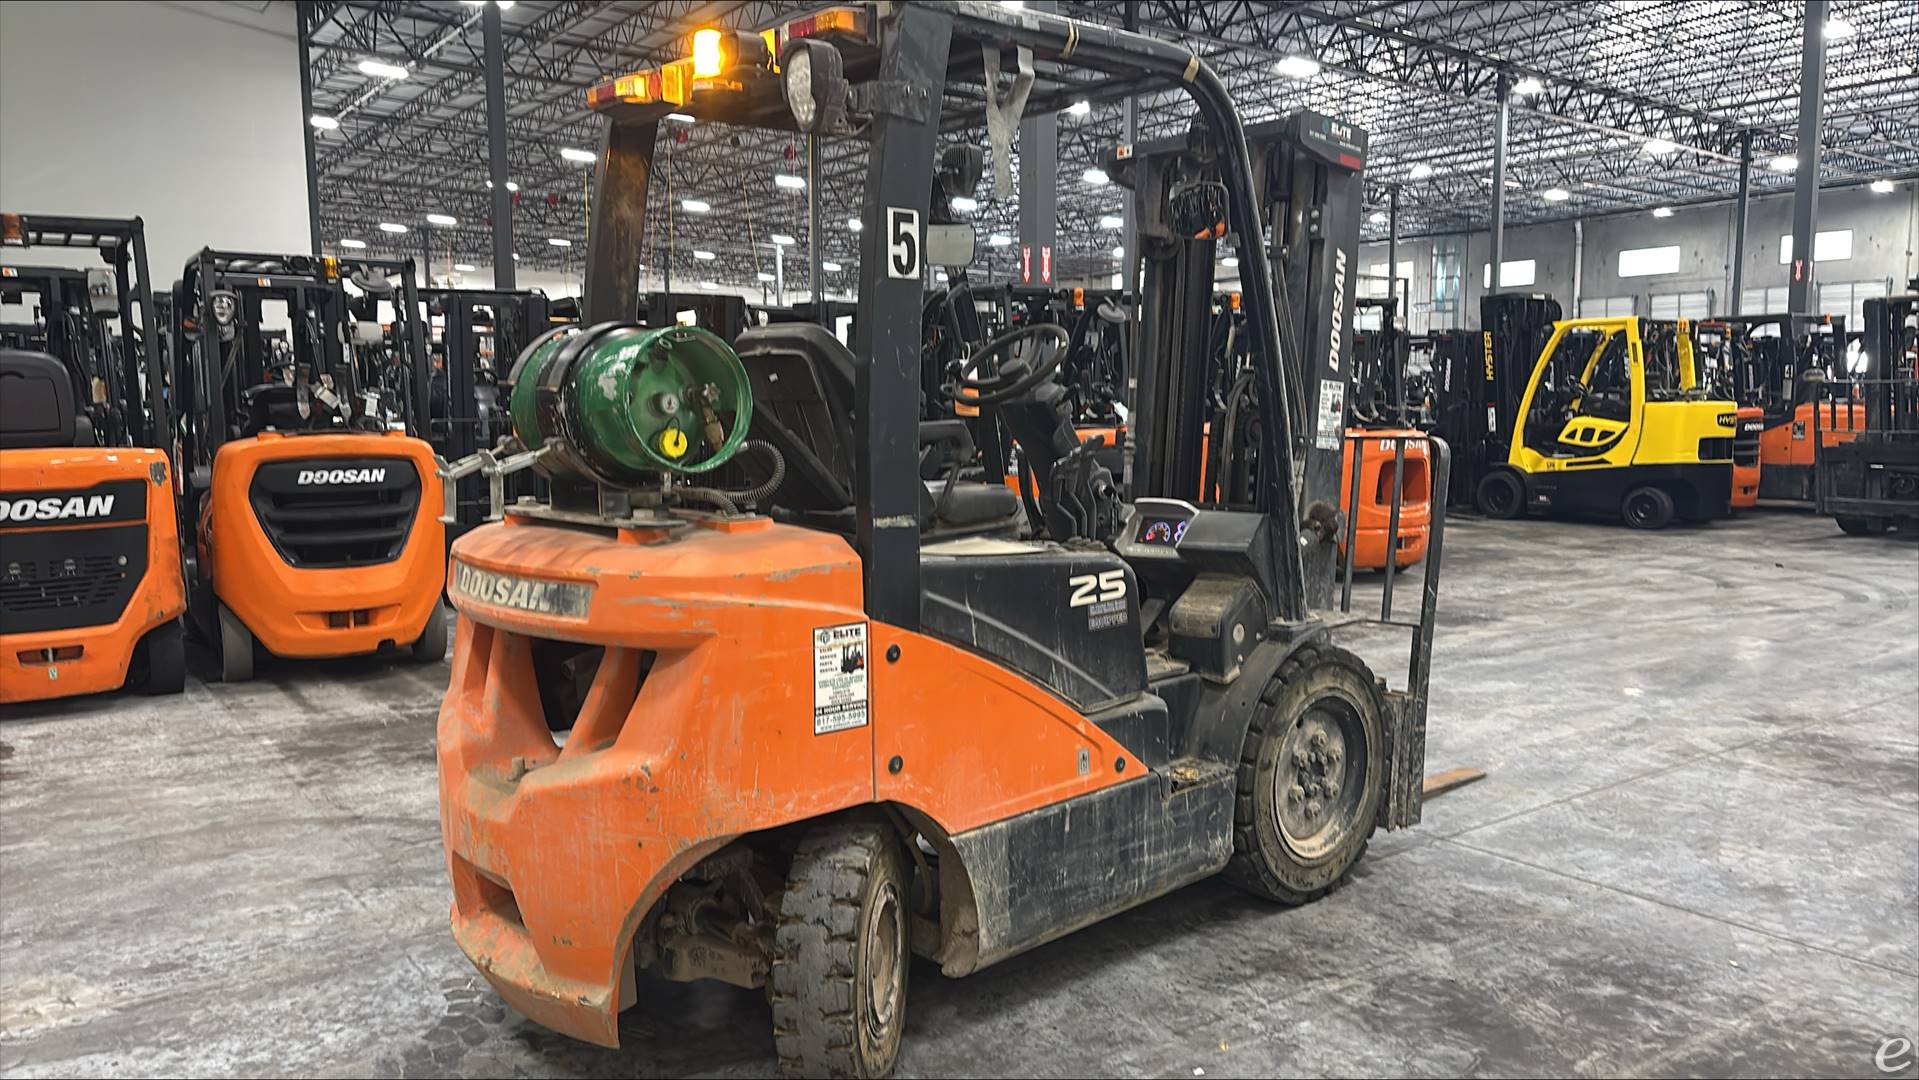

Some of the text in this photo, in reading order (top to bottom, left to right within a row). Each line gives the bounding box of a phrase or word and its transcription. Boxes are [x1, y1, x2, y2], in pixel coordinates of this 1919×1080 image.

[893, 211, 916, 275] 5
[1329, 247, 1347, 373] DOOSAN
[1484, 330, 1494, 380] HYSTER
[297, 467, 386, 485] DOOSAN
[1069, 569, 1126, 608] 25
[833, 628, 861, 639] ELITE
